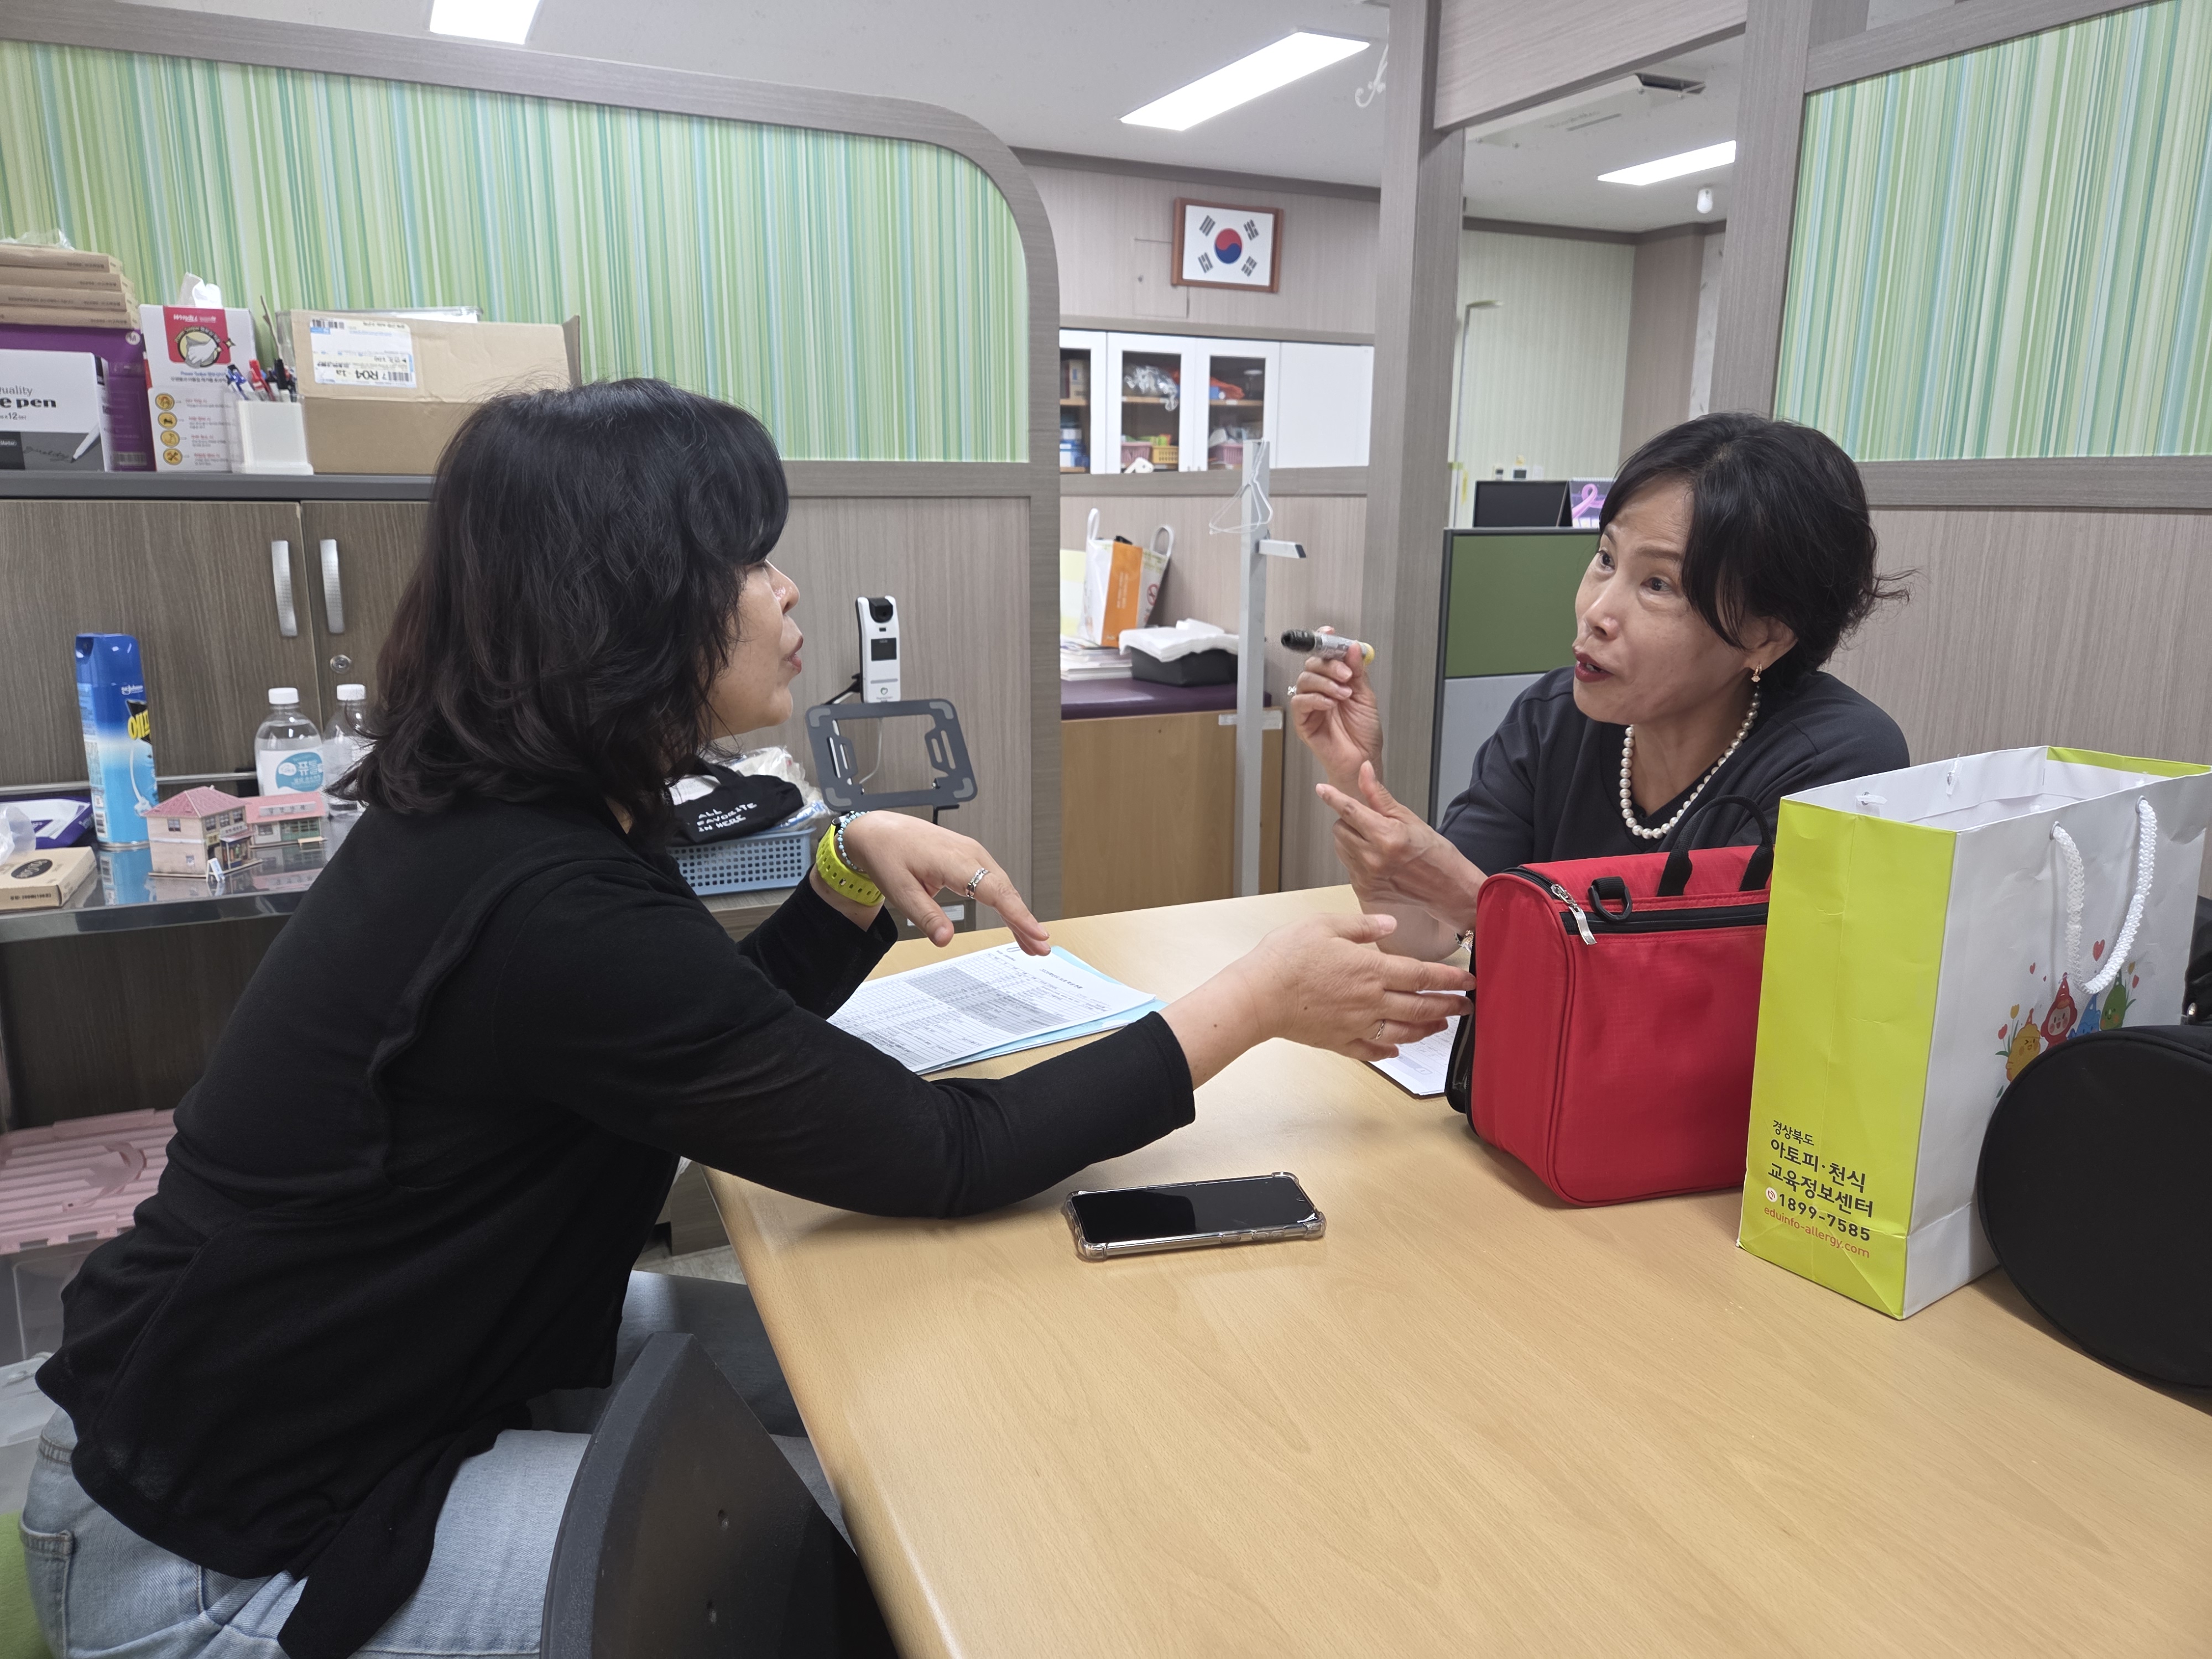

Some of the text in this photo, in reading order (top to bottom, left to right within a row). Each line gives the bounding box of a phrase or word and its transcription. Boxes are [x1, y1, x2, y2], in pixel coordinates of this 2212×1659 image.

[0, 385, 33, 397] uality
[16, 398, 56, 409] pen
[697, 802, 757, 826] FAVORITE
[698, 808, 723, 820] ALL
[715, 814, 746, 828] HERE
[1772, 1120, 1814, 1146] 경상북도
[1771, 1139, 1866, 1193] 아토피·천식
[1768, 1162, 1874, 1218] 교육정보센터
[1779, 1193, 1870, 1241] 1899-7585
[1764, 1207, 1870, 1259] eduinfo-allergy.com
